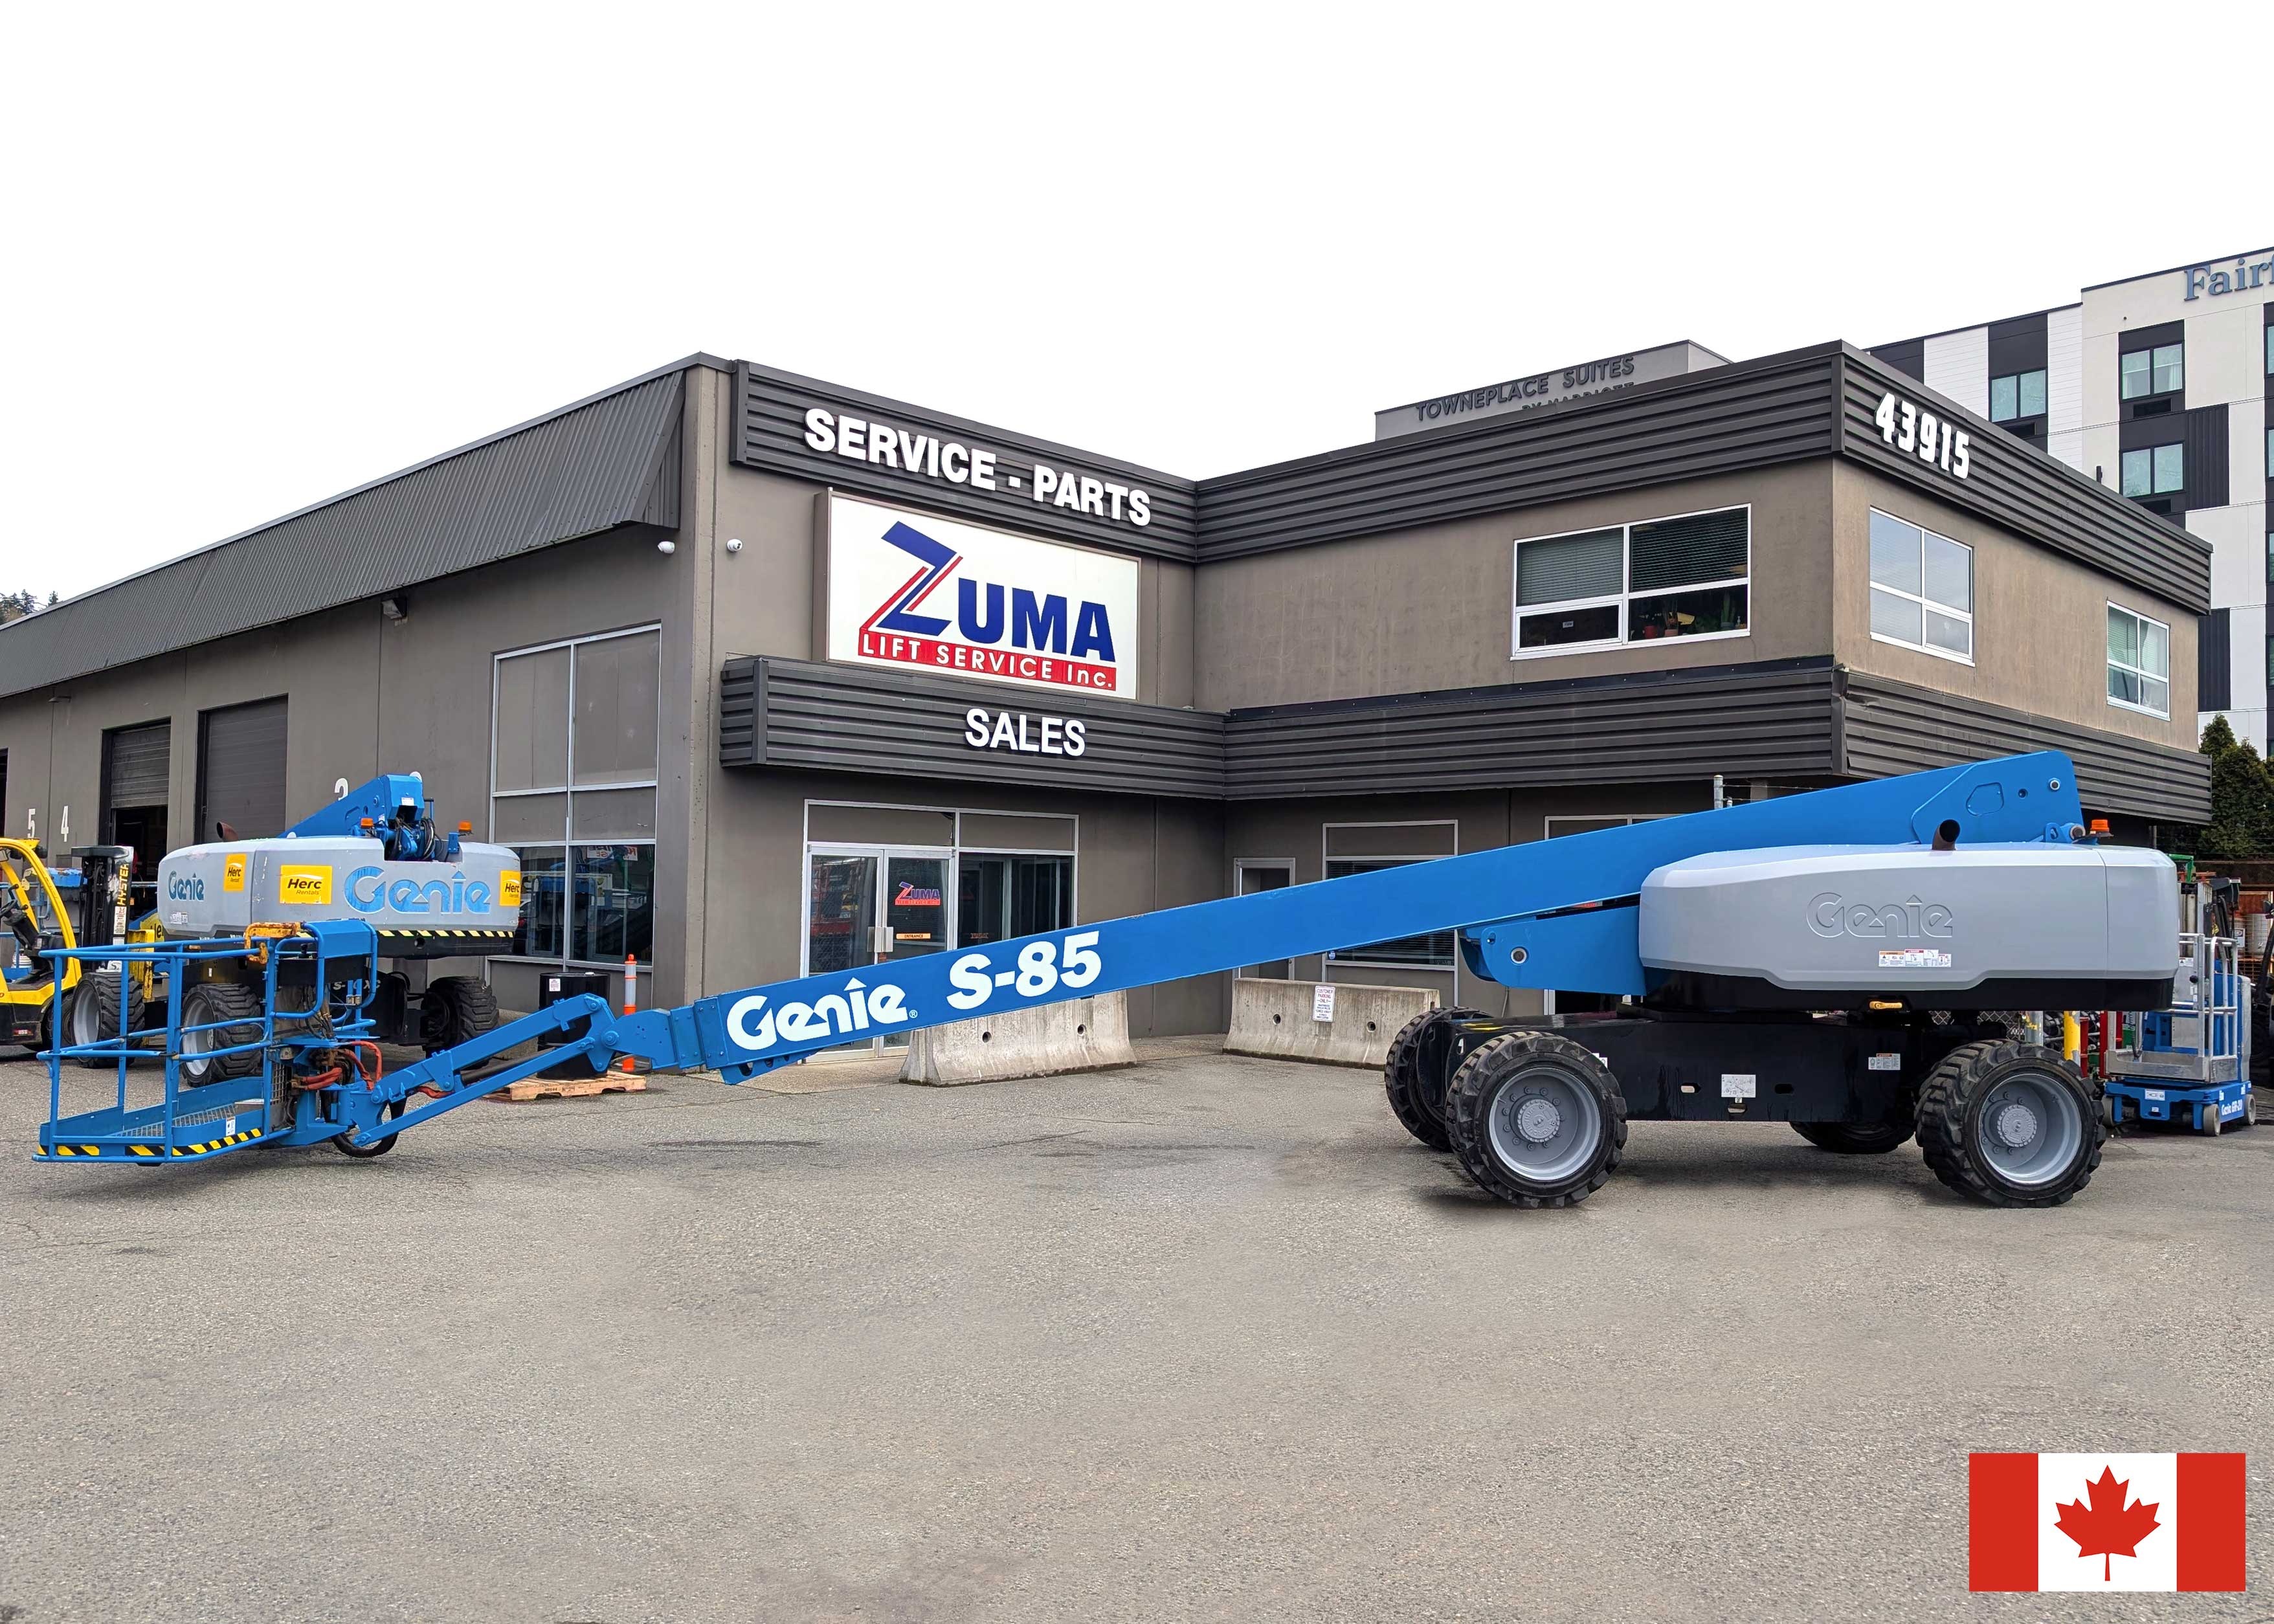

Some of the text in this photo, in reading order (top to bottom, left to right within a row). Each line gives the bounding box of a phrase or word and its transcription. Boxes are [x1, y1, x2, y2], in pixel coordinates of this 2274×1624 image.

[1415, 375, 1549, 421] TOWNEPLACE
[1563, 357, 1635, 388] SUITES
[1875, 392, 1970, 480] 43915
[804, 408, 998, 491] SERVICE
[1033, 464, 1152, 527] PARTS
[861, 521, 1117, 663] ZUMA
[863, 634, 1113, 688] LIFT SERVICE Inc.
[965, 707, 1086, 757] SALES
[27, 808, 36, 838] 5
[61, 806, 69, 842] 4
[117, 863, 129, 906] HYSTER
[168, 871, 205, 901] Genie
[227, 867, 241, 878] Herc
[287, 878, 322, 889] Herc
[344, 866, 491, 915] Genie
[505, 883, 520, 893] Herc
[896, 881, 941, 900] ZUMA
[1806, 892, 1953, 938] Genie
[946, 930, 1102, 1010] S-85
